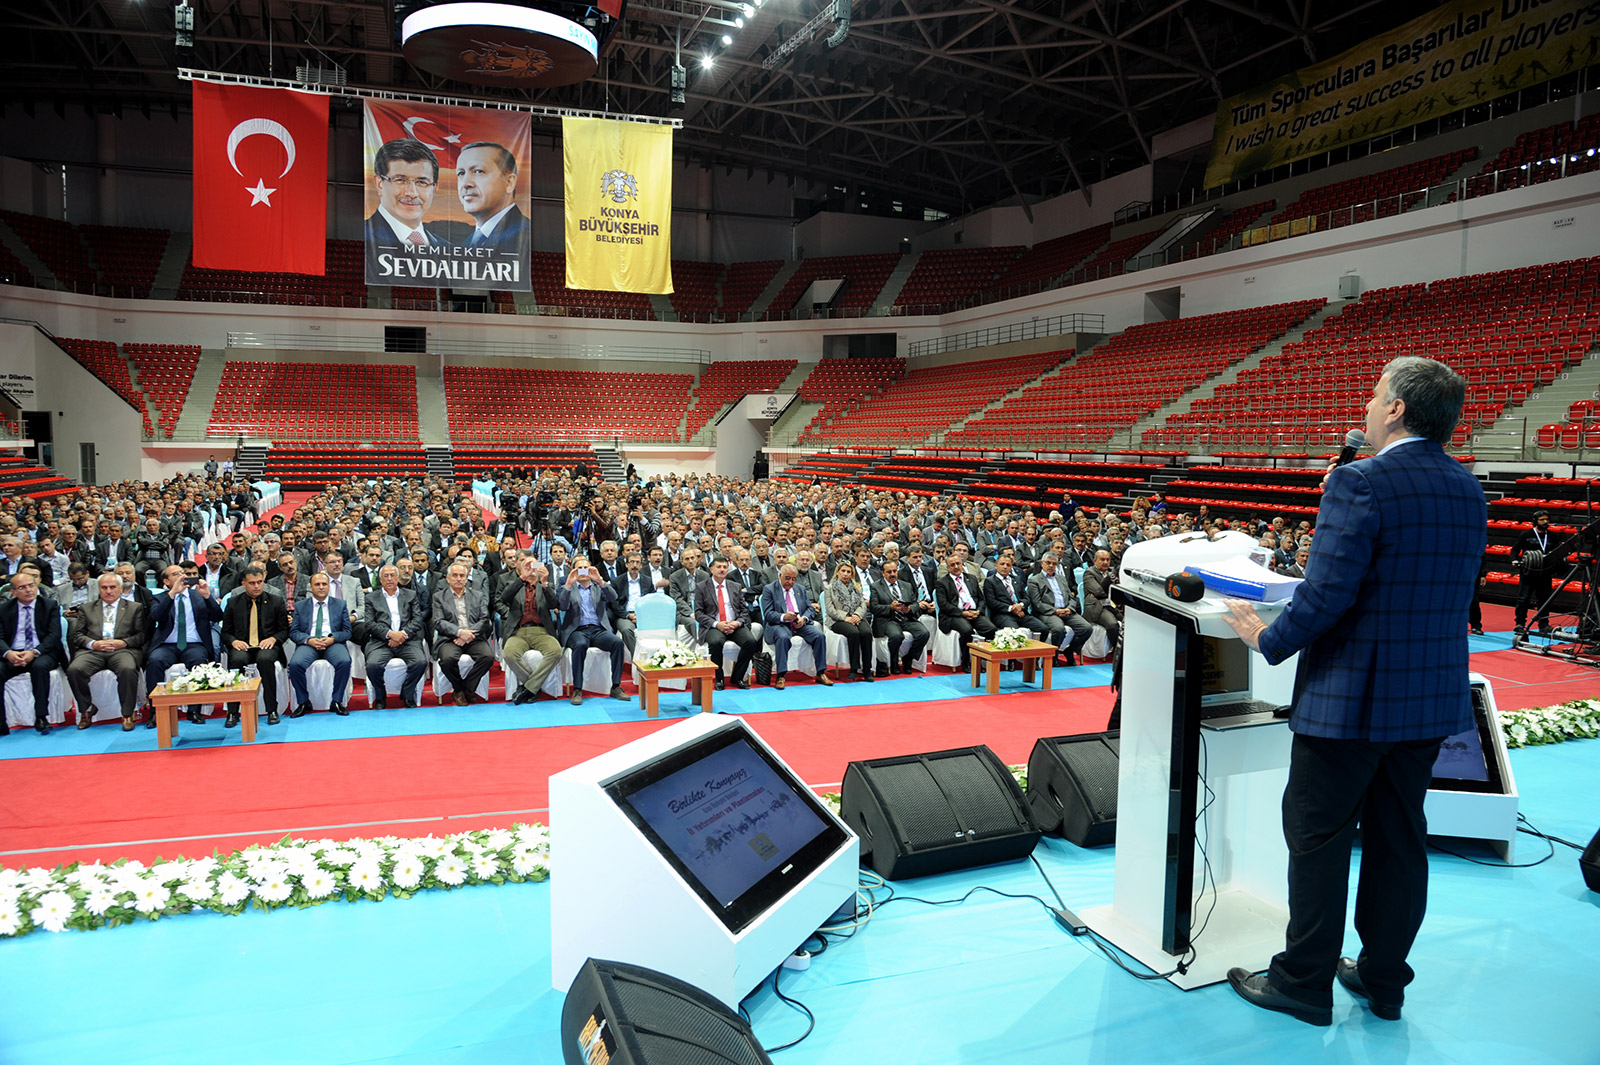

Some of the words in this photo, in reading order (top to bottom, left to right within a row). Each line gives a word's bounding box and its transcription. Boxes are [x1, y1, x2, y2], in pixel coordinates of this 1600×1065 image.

[1232, 102, 1266, 127] Tüm
[1270, 58, 1376, 114] Sporculara
[1382, 6, 1494, 71] Başarılar
[1225, 134, 1234, 156] I
[1235, 123, 1274, 152] wish
[1276, 121, 1290, 138] a
[1290, 100, 1343, 139] great
[1344, 70, 1426, 116] success
[1431, 58, 1455, 83] to
[1460, 35, 1495, 72] all
[600, 206, 640, 220] KONYA
[579, 216, 660, 236] BÜYÜKŞEHİR
[595, 234, 644, 245] BELEDİYESİ
[404, 244, 494, 258] MEMLEKET
[377, 253, 520, 282] SEVDALILARI
[667, 789, 707, 814] Birlikte
